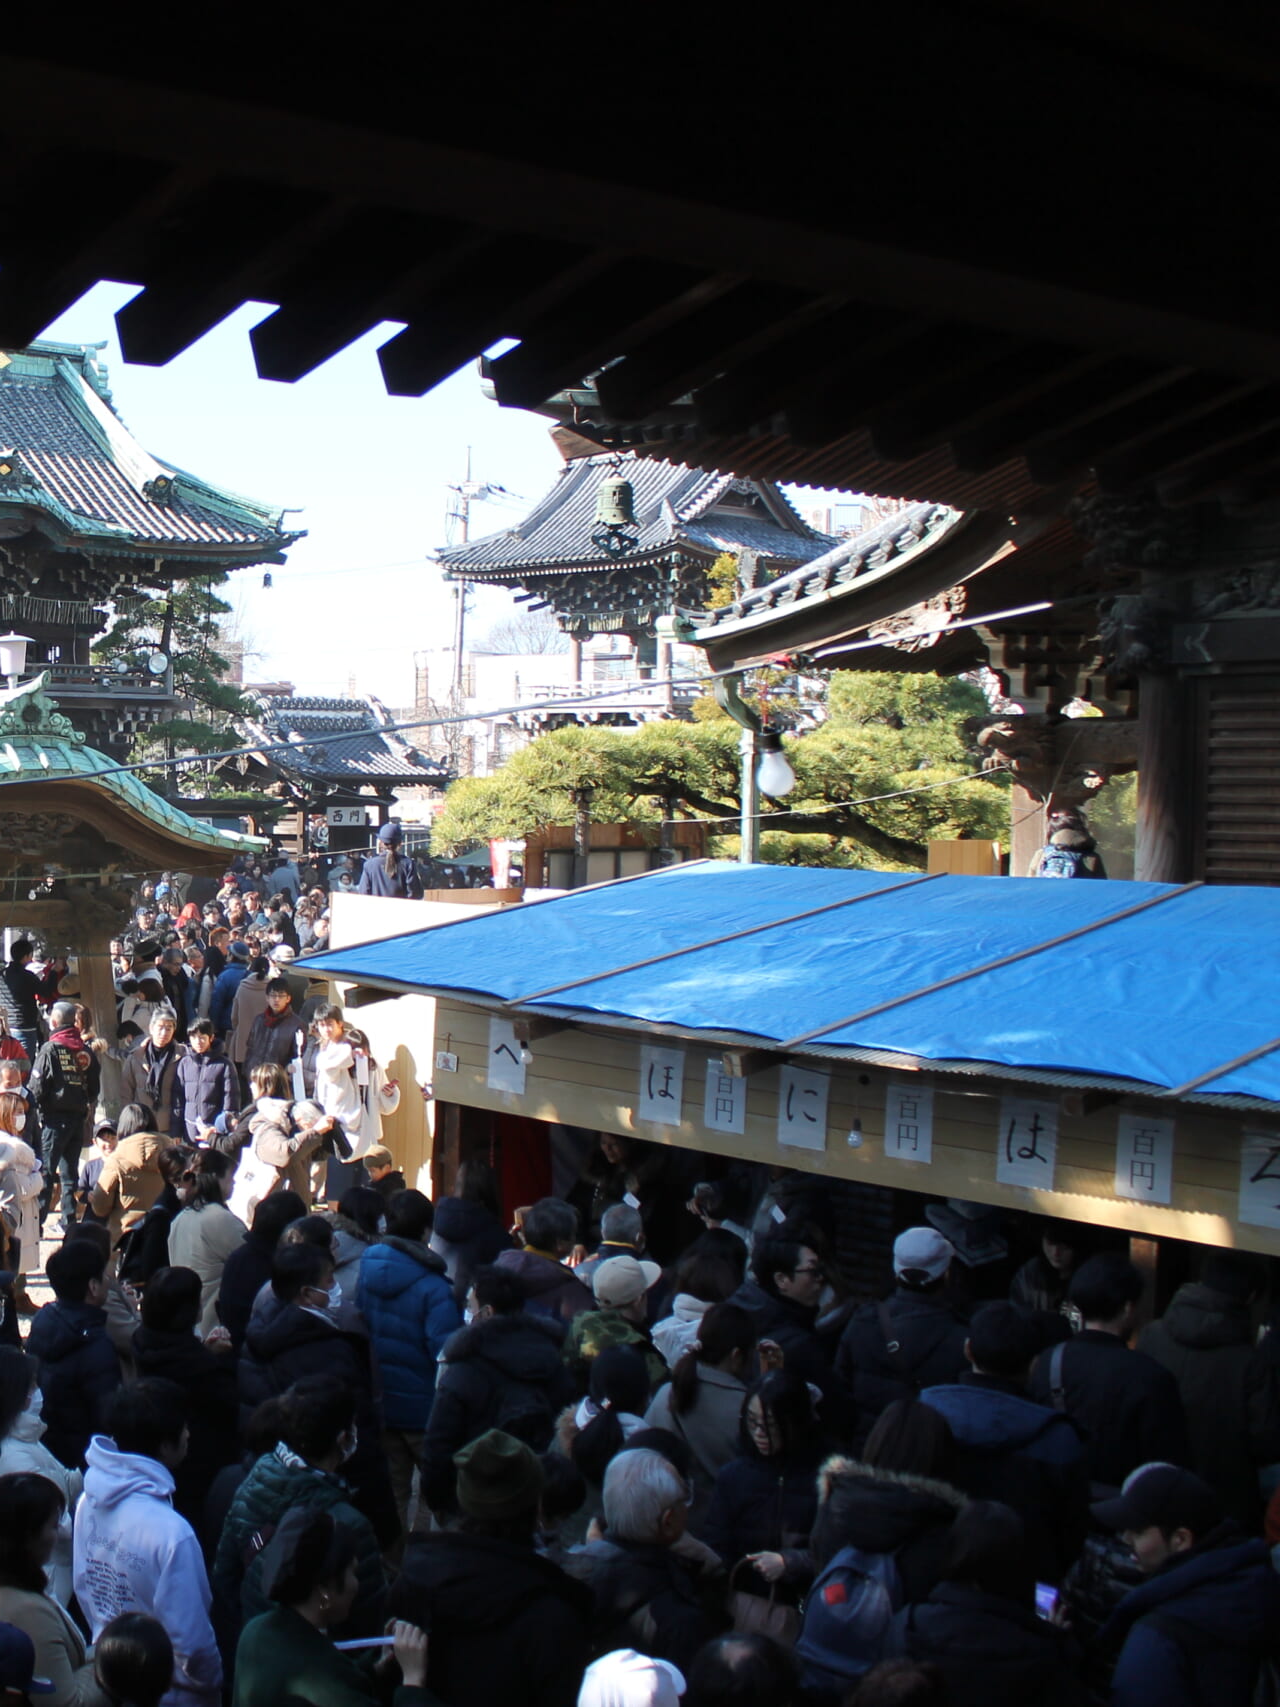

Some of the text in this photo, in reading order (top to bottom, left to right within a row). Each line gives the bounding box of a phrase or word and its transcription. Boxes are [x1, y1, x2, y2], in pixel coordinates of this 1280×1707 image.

[333, 810, 360, 823] 西門
[494, 1043, 520, 1065] へ
[648, 1062, 675, 1100] ほ
[787, 1082, 819, 1122] に
[897, 1094, 923, 1151] 百円
[1006, 1113, 1048, 1163] は
[1129, 1127, 1161, 1191] 百円
